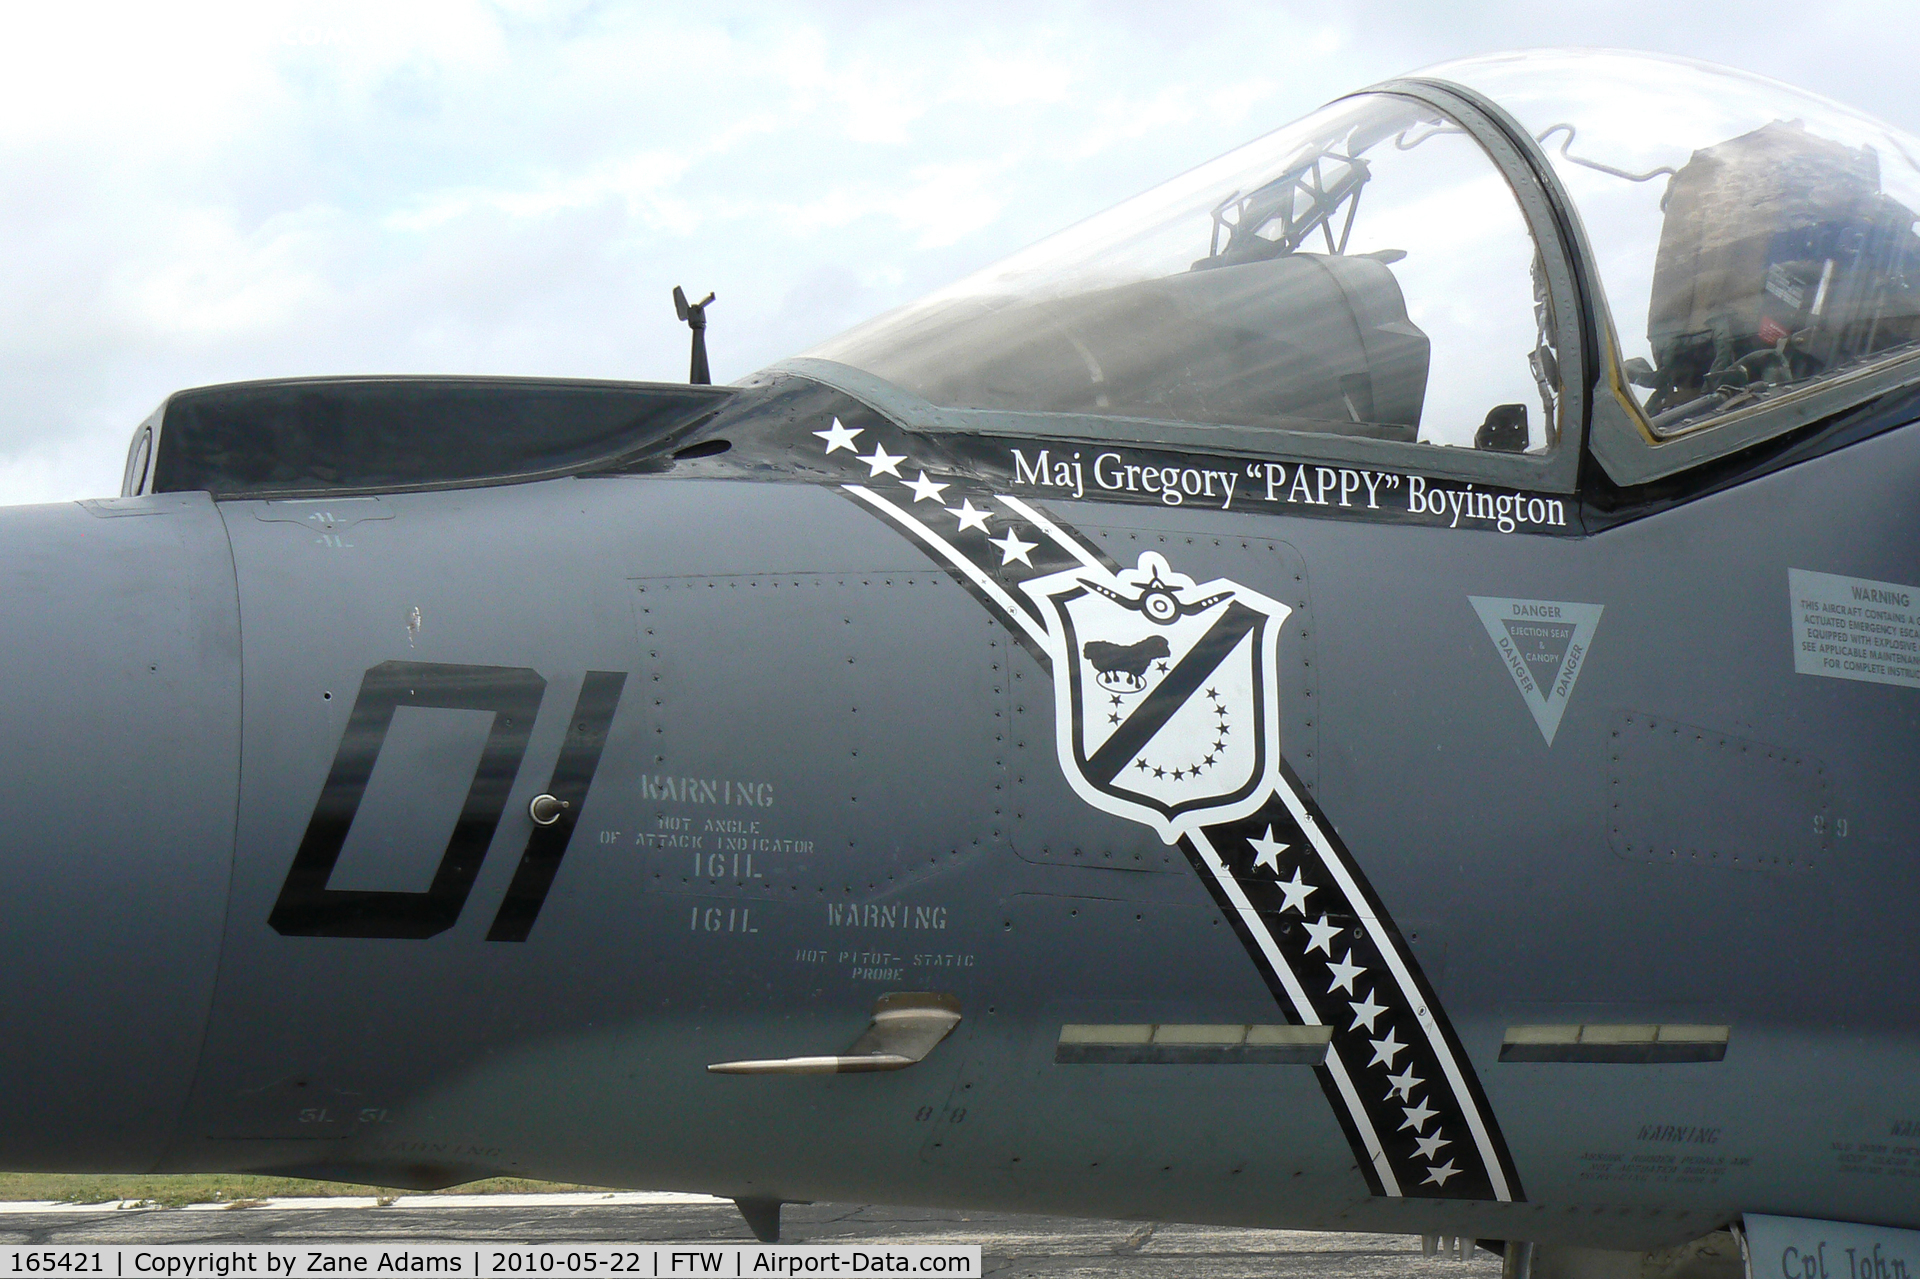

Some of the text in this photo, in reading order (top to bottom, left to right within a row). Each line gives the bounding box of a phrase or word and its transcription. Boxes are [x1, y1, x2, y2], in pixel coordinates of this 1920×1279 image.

[1011, 449, 1085, 498] Maj
[1094, 453, 1238, 509] Gregory
[1407, 476, 1567, 533] Boyington
[1851, 586, 1910, 607] WARNING
[1512, 604, 1561, 618] DANGER
[1801, 600, 1819, 611] THIS
[1822, 603, 1862, 617] AIRCRAFT
[1865, 609, 1905, 623] CONTAINS
[1908, 615, 1915, 625] A
[1511, 626, 1570, 638] EJECTION SEAT
[1804, 614, 1845, 628] ACTUATED
[1849, 620, 1897, 635] EMERGENCY
[1802, 641, 1816, 652] SEE
[1819, 643, 1867, 658] APPLICABLE
[1807, 628, 1848, 642] EQUIPPED
[1850, 634, 1871, 645] WITH
[1874, 637, 1917, 652] EXPLOSIVE
[1499, 637, 1534, 694] DANGER
[1525, 653, 1560, 663] CANOPY
[1823, 658, 1840, 669] FOR
[1844, 661, 1885, 674] COMPLETE
[1556, 644, 1583, 697] DANGER
[641, 774, 773, 807] WARNING
[657, 816, 760, 834] HOT ANGLE
[599, 831, 814, 853] OF ATTACK INDICATOR
[828, 903, 947, 929] WARNING
[795, 949, 827, 963] HOT
[913, 954, 974, 967] STATIC
[852, 967, 904, 981] PROBE
[1637, 1124, 1721, 1144] WARNING
[1782, 1241, 1910, 1279] Cpl John
